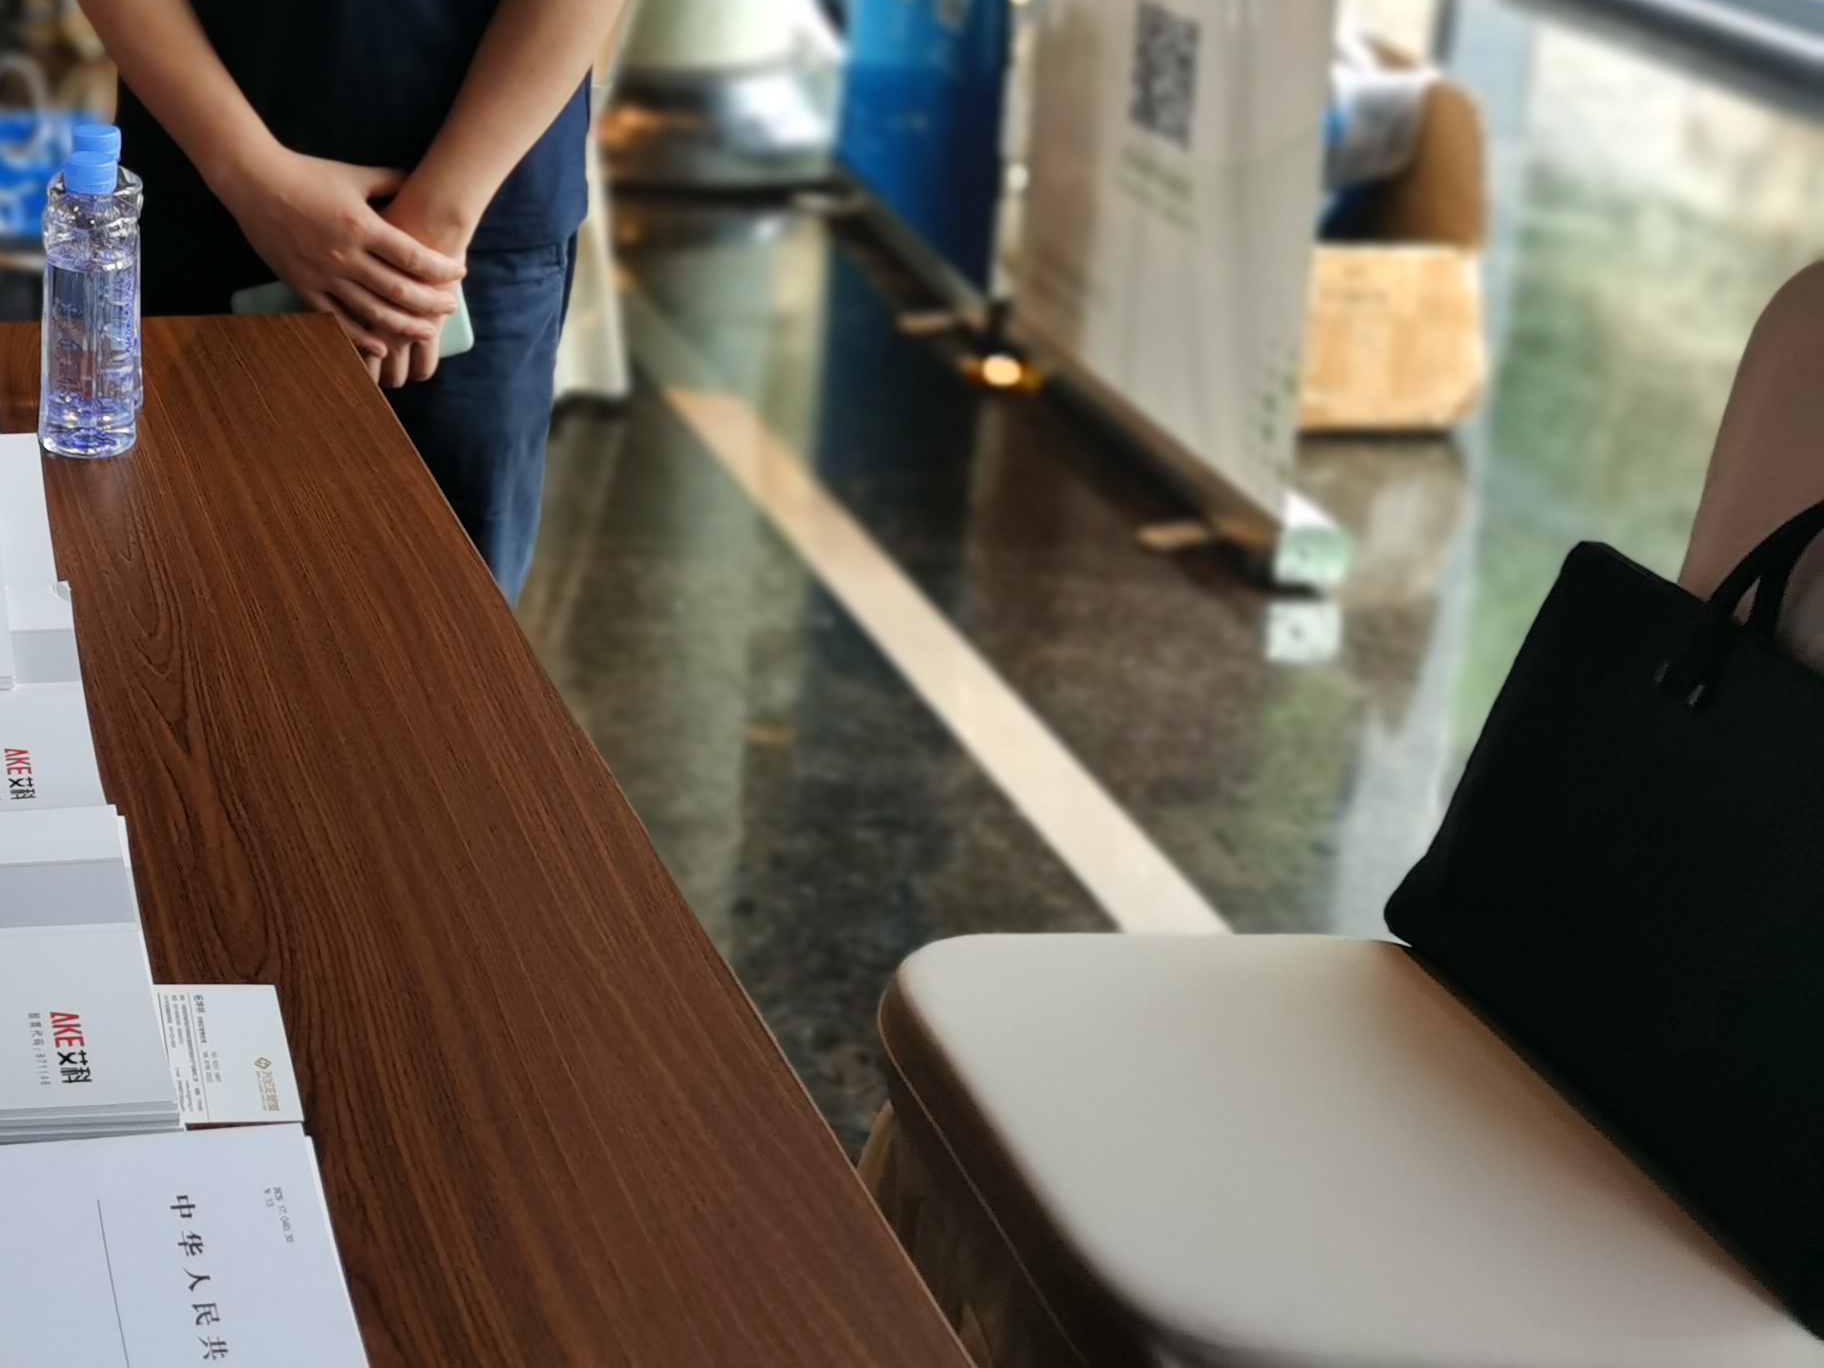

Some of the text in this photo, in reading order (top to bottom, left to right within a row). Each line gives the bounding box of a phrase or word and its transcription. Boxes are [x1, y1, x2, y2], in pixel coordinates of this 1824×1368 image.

[169, 1194, 229, 1361] 中华人民共
